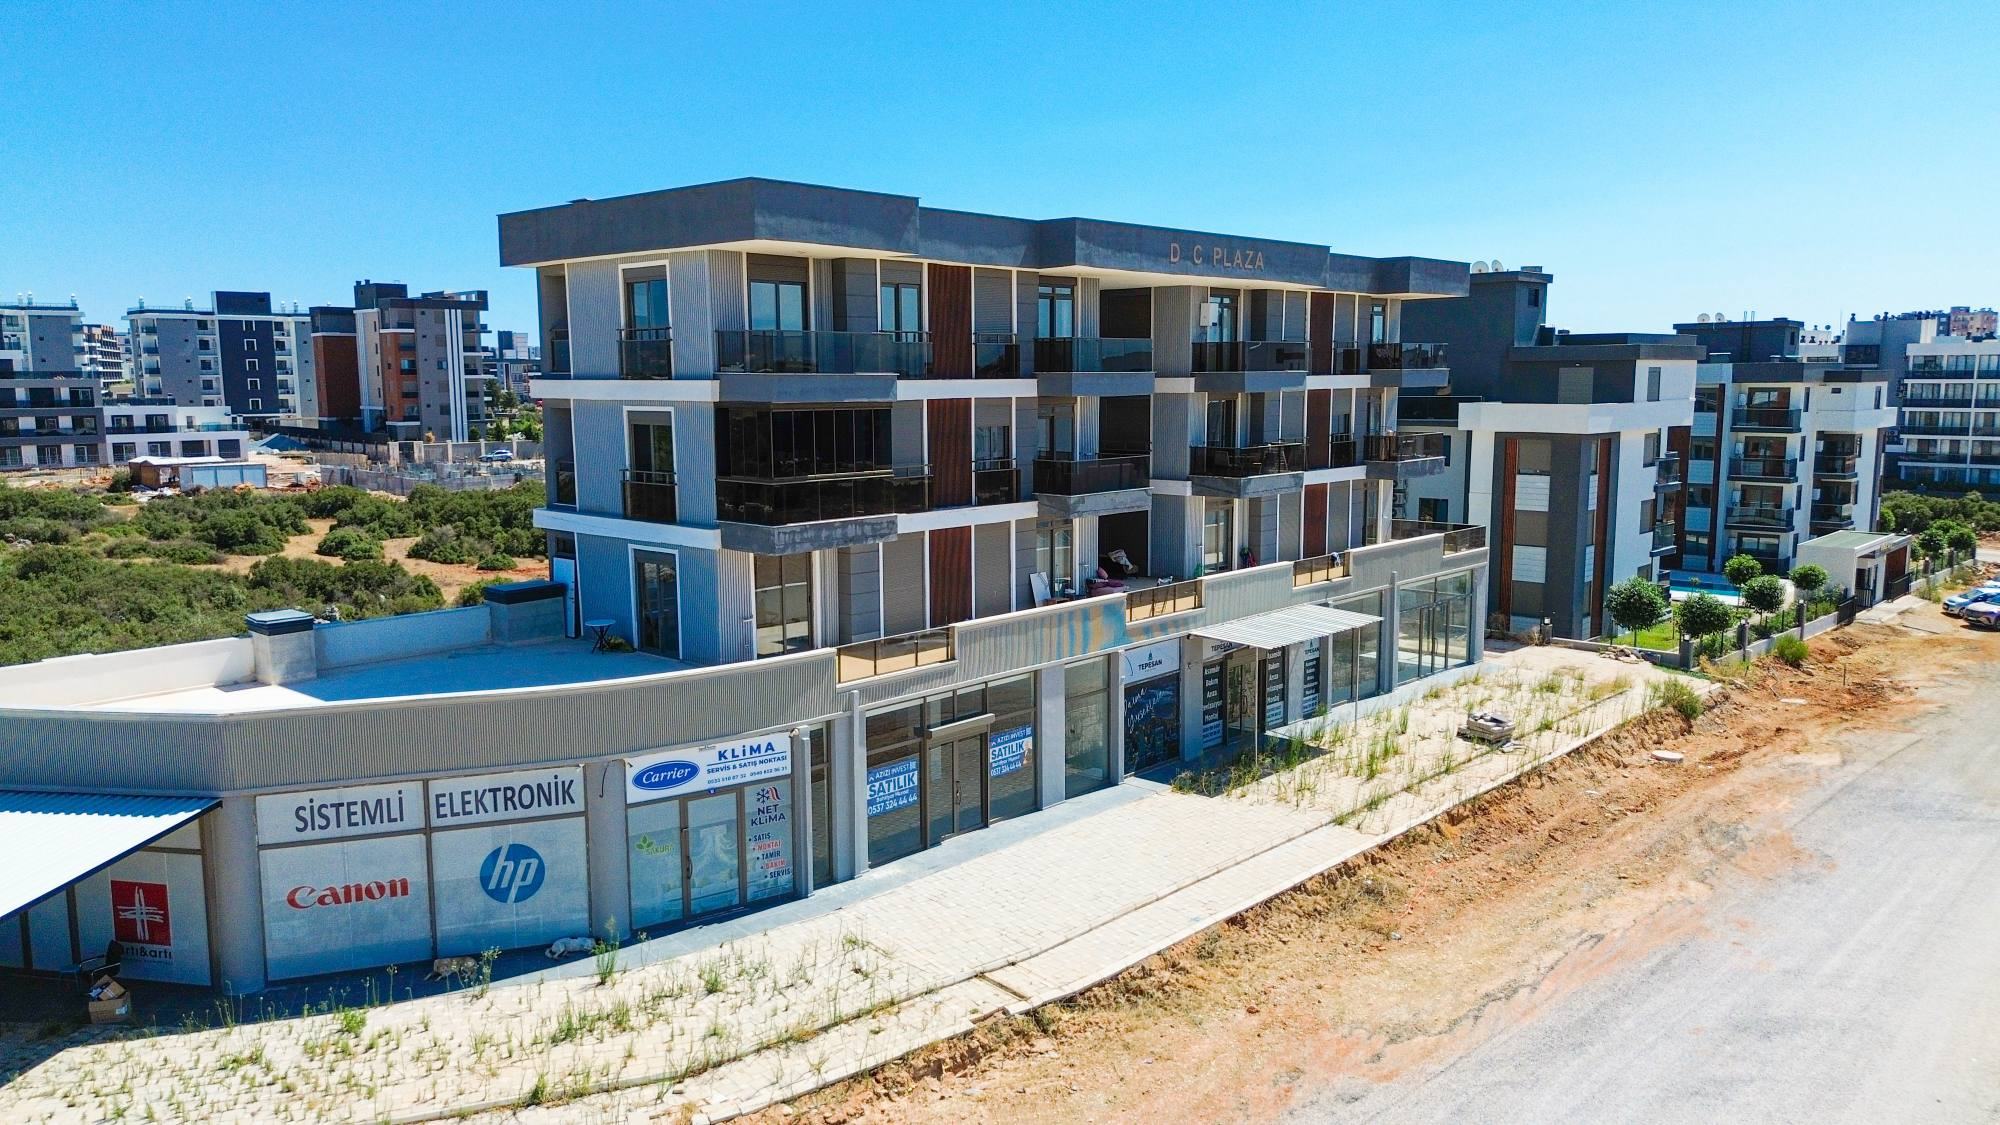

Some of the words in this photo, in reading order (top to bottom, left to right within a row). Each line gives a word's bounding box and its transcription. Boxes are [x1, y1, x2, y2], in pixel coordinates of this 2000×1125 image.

[1170, 242, 1181, 263] D
[1193, 244, 1203, 265] C
[1213, 247, 1265, 270] PLAZA
[1138, 659, 1163, 671] TEPESAN
[991, 740, 1025, 760] SATILIK
[759, 755, 787, 766] NOKTASI
[642, 766, 691, 784] Carrier
[868, 772, 916, 798] SATILIK
[294, 789, 405, 833] SİSTEMLİ
[434, 774, 577, 820] ELEKTRONİK
[757, 803, 779, 816] NET
[868, 803, 884, 815] 0537
[886, 799, 898, 810] 324
[486, 844, 540, 904] hp
[286, 877, 410, 909] Canon
